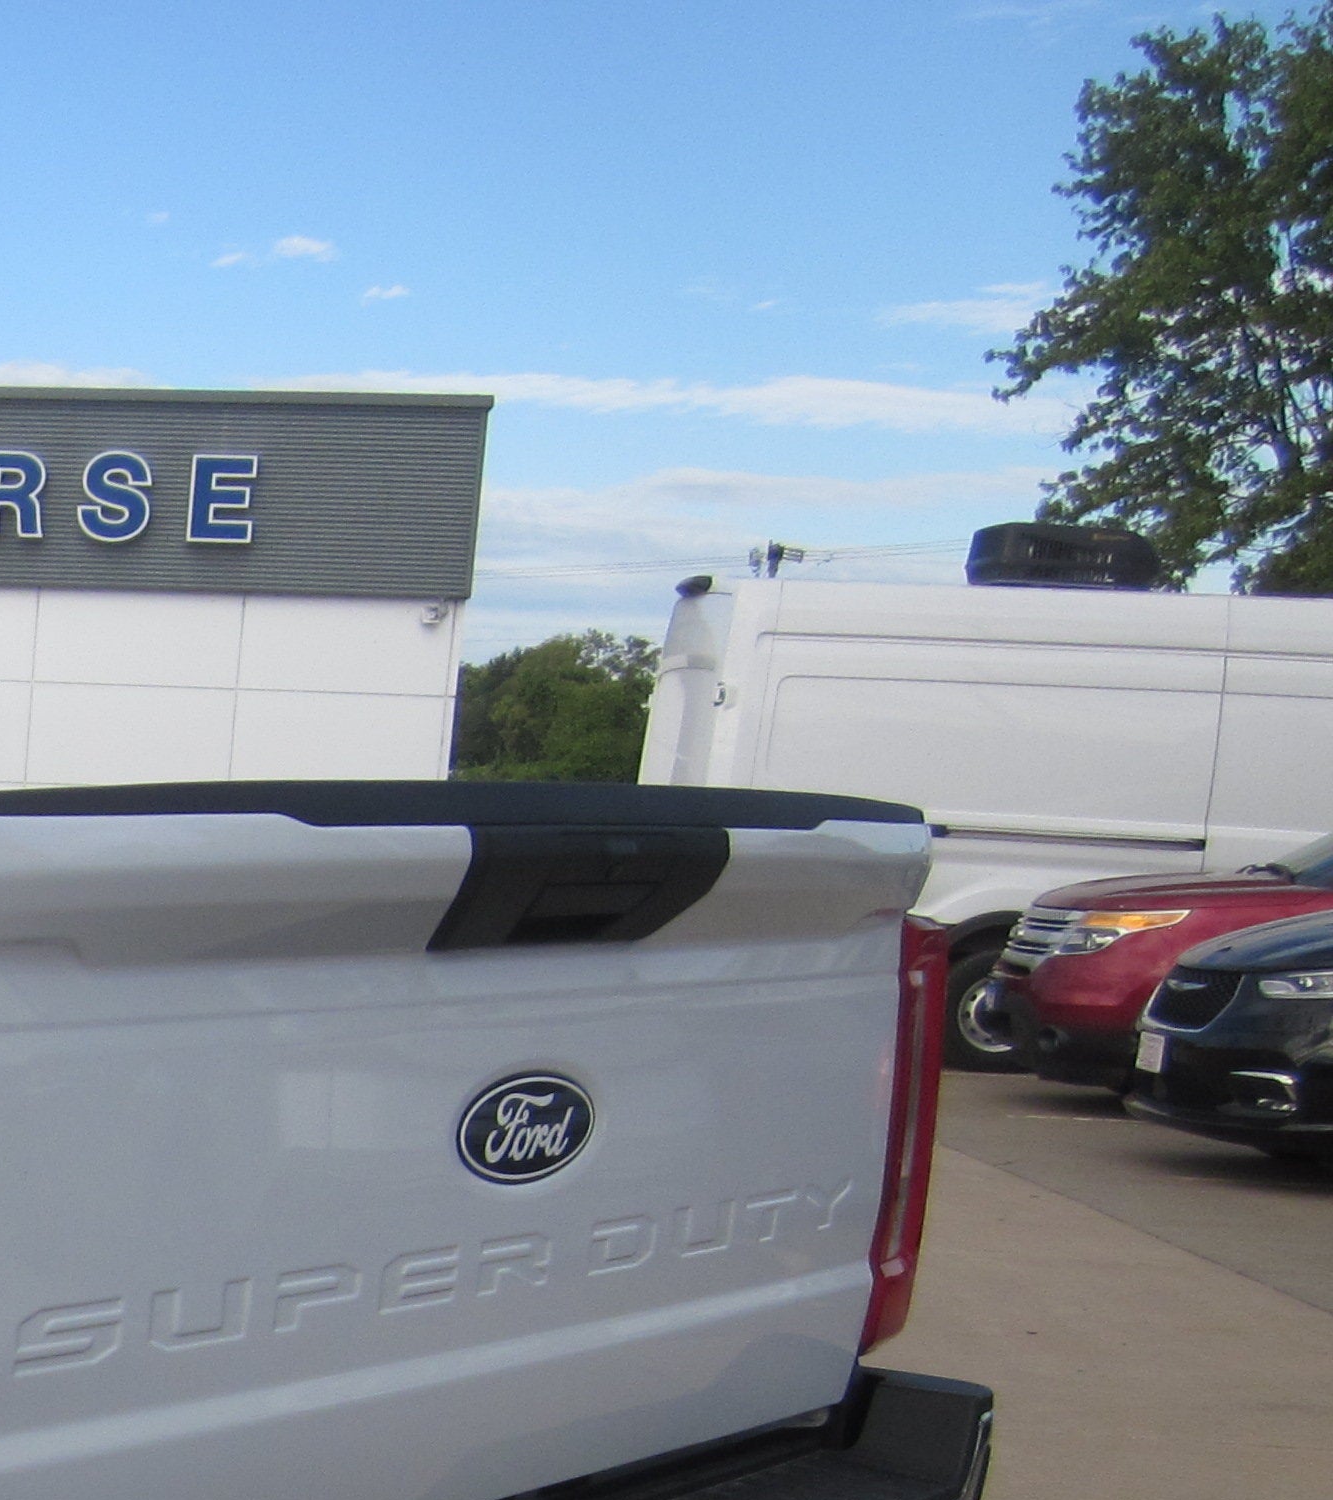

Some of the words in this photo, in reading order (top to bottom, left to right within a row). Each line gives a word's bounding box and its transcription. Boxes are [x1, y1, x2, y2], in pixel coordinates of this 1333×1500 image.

[484, 1092, 575, 1164] Ford
[13, 1230, 553, 1378] SUPER
[587, 1178, 854, 1278] DUTY
